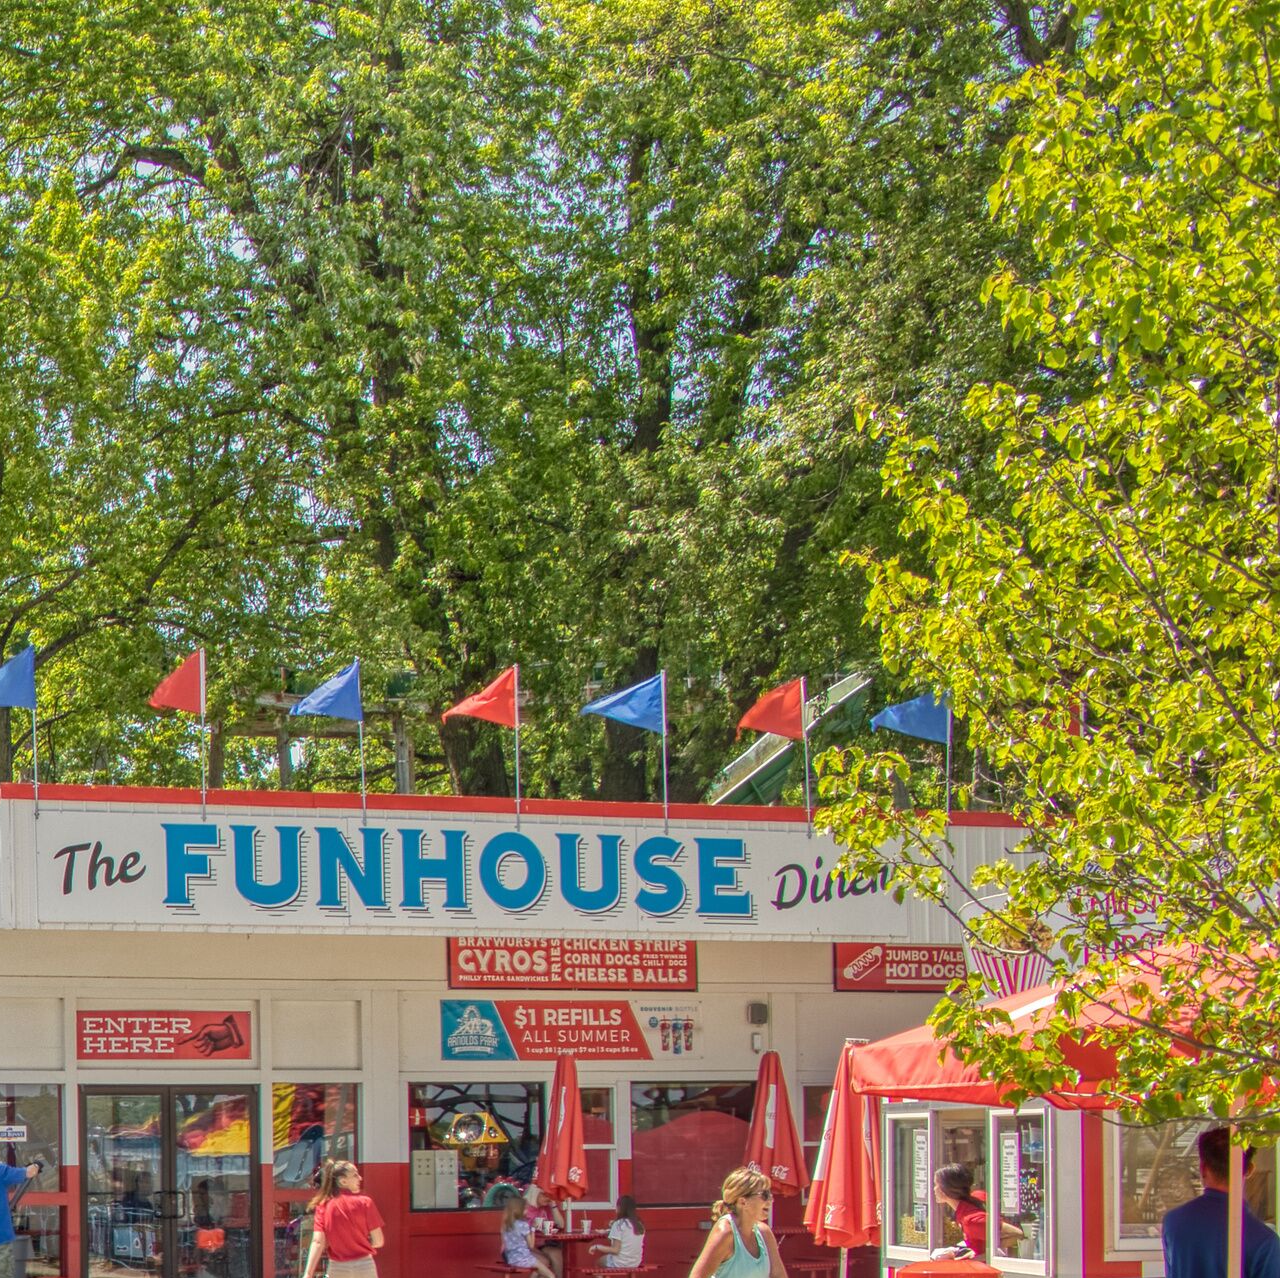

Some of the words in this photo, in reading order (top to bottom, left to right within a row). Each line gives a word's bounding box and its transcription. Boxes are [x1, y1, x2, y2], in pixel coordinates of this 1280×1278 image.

[53, 840, 146, 895] The
[160, 823, 756, 920] FUNHOUSE
[458, 936, 548, 948] BRATWURSTS
[563, 938, 630, 951] CHICKEN
[634, 940, 688, 952] STRIPS
[458, 949, 549, 974] GYROS
[551, 938, 561, 982] FRIES
[564, 953, 601, 965] CORN
[605, 953, 640, 966] DOGS
[642, 959, 665, 967] CHILI
[885, 950, 929, 961] JUMBO
[932, 949, 964, 963] 1/4LB
[564, 967, 628, 982] CHEESE
[633, 968, 688, 983] BALLS
[885, 964, 918, 977] HOT
[921, 964, 965, 978] DOGS
[514, 1005, 536, 1029] $1
[543, 1008, 622, 1026] REFILLS
[83, 1017, 192, 1034] ENTER
[522, 1030, 551, 1042] ALL
[558, 1030, 630, 1042] SUMMER
[83, 1037, 175, 1053] HERE
